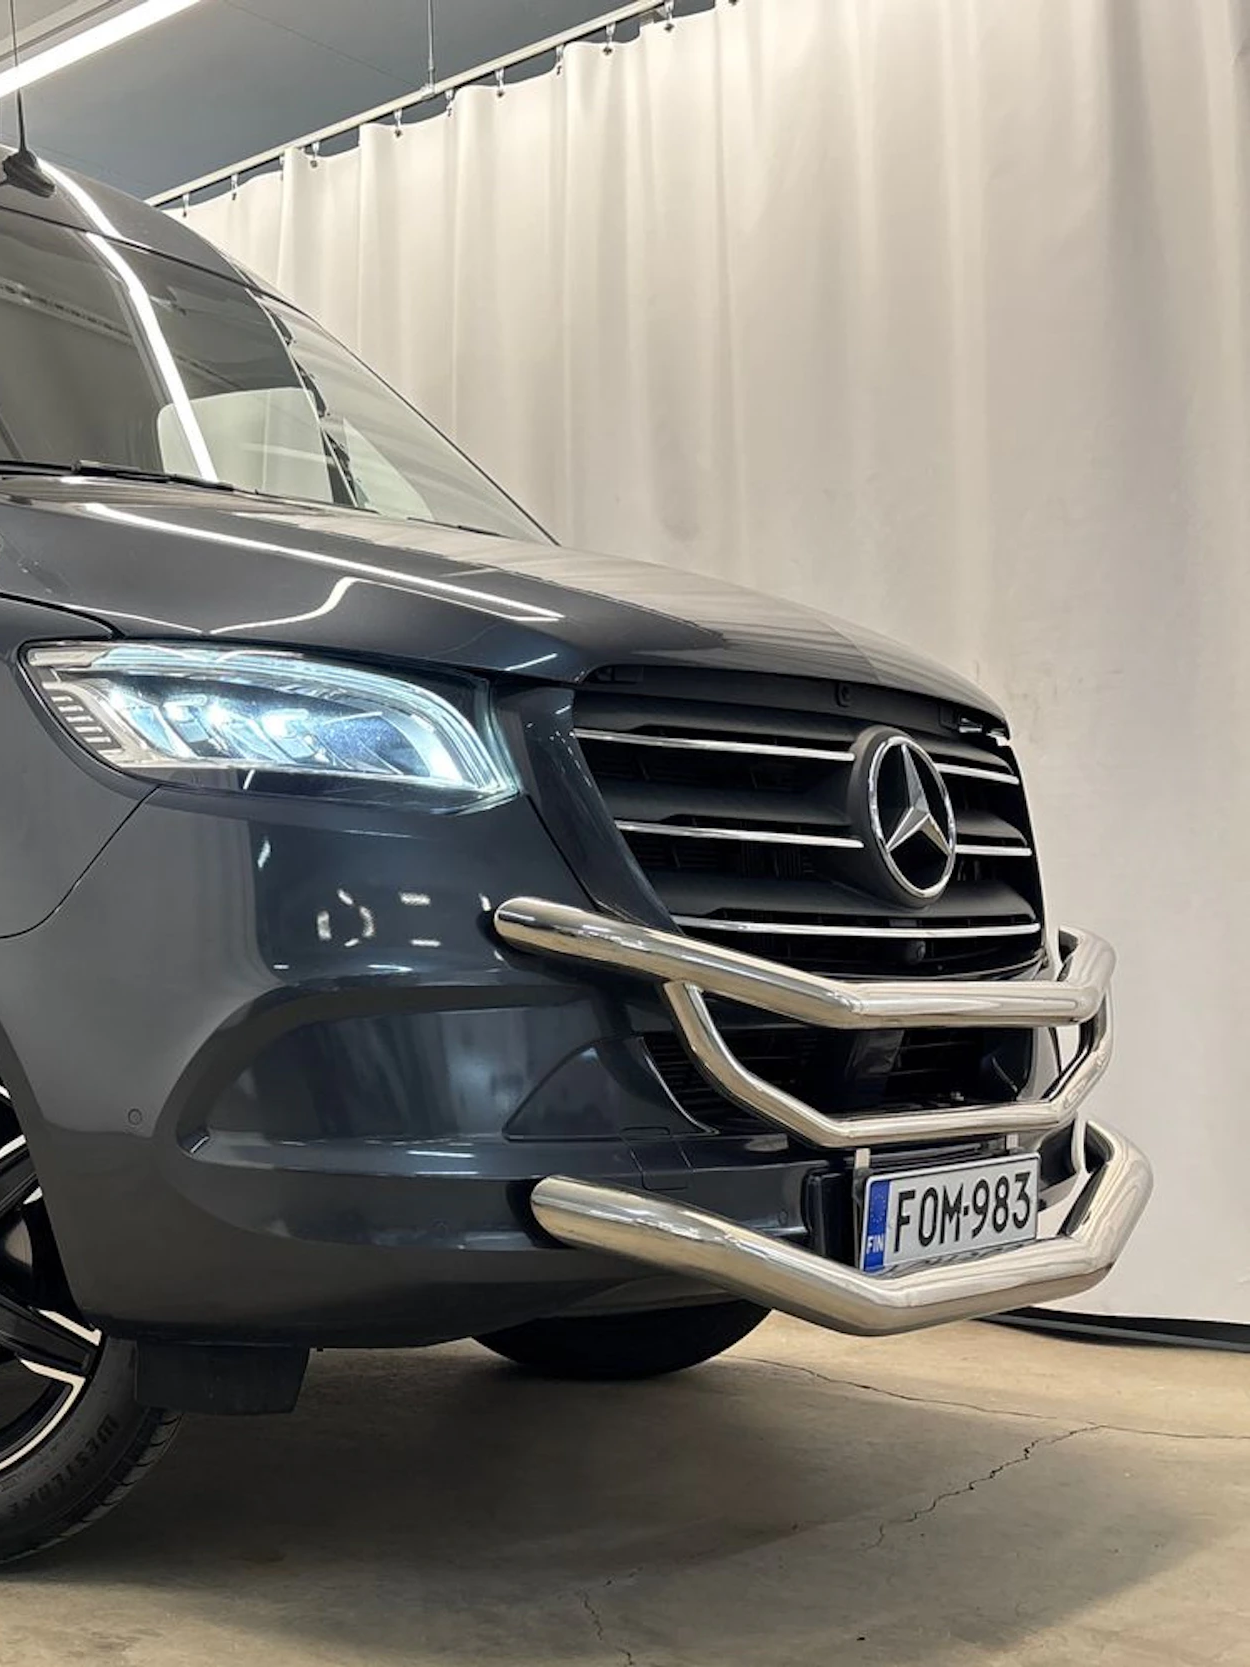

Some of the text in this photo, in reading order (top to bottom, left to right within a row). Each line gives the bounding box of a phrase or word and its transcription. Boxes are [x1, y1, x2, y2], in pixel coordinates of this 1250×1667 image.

[866, 1234, 885, 1254] FIN
[893, 1171, 1031, 1253] FOM-983
[8, 1414, 120, 1519] WESTLAKE
